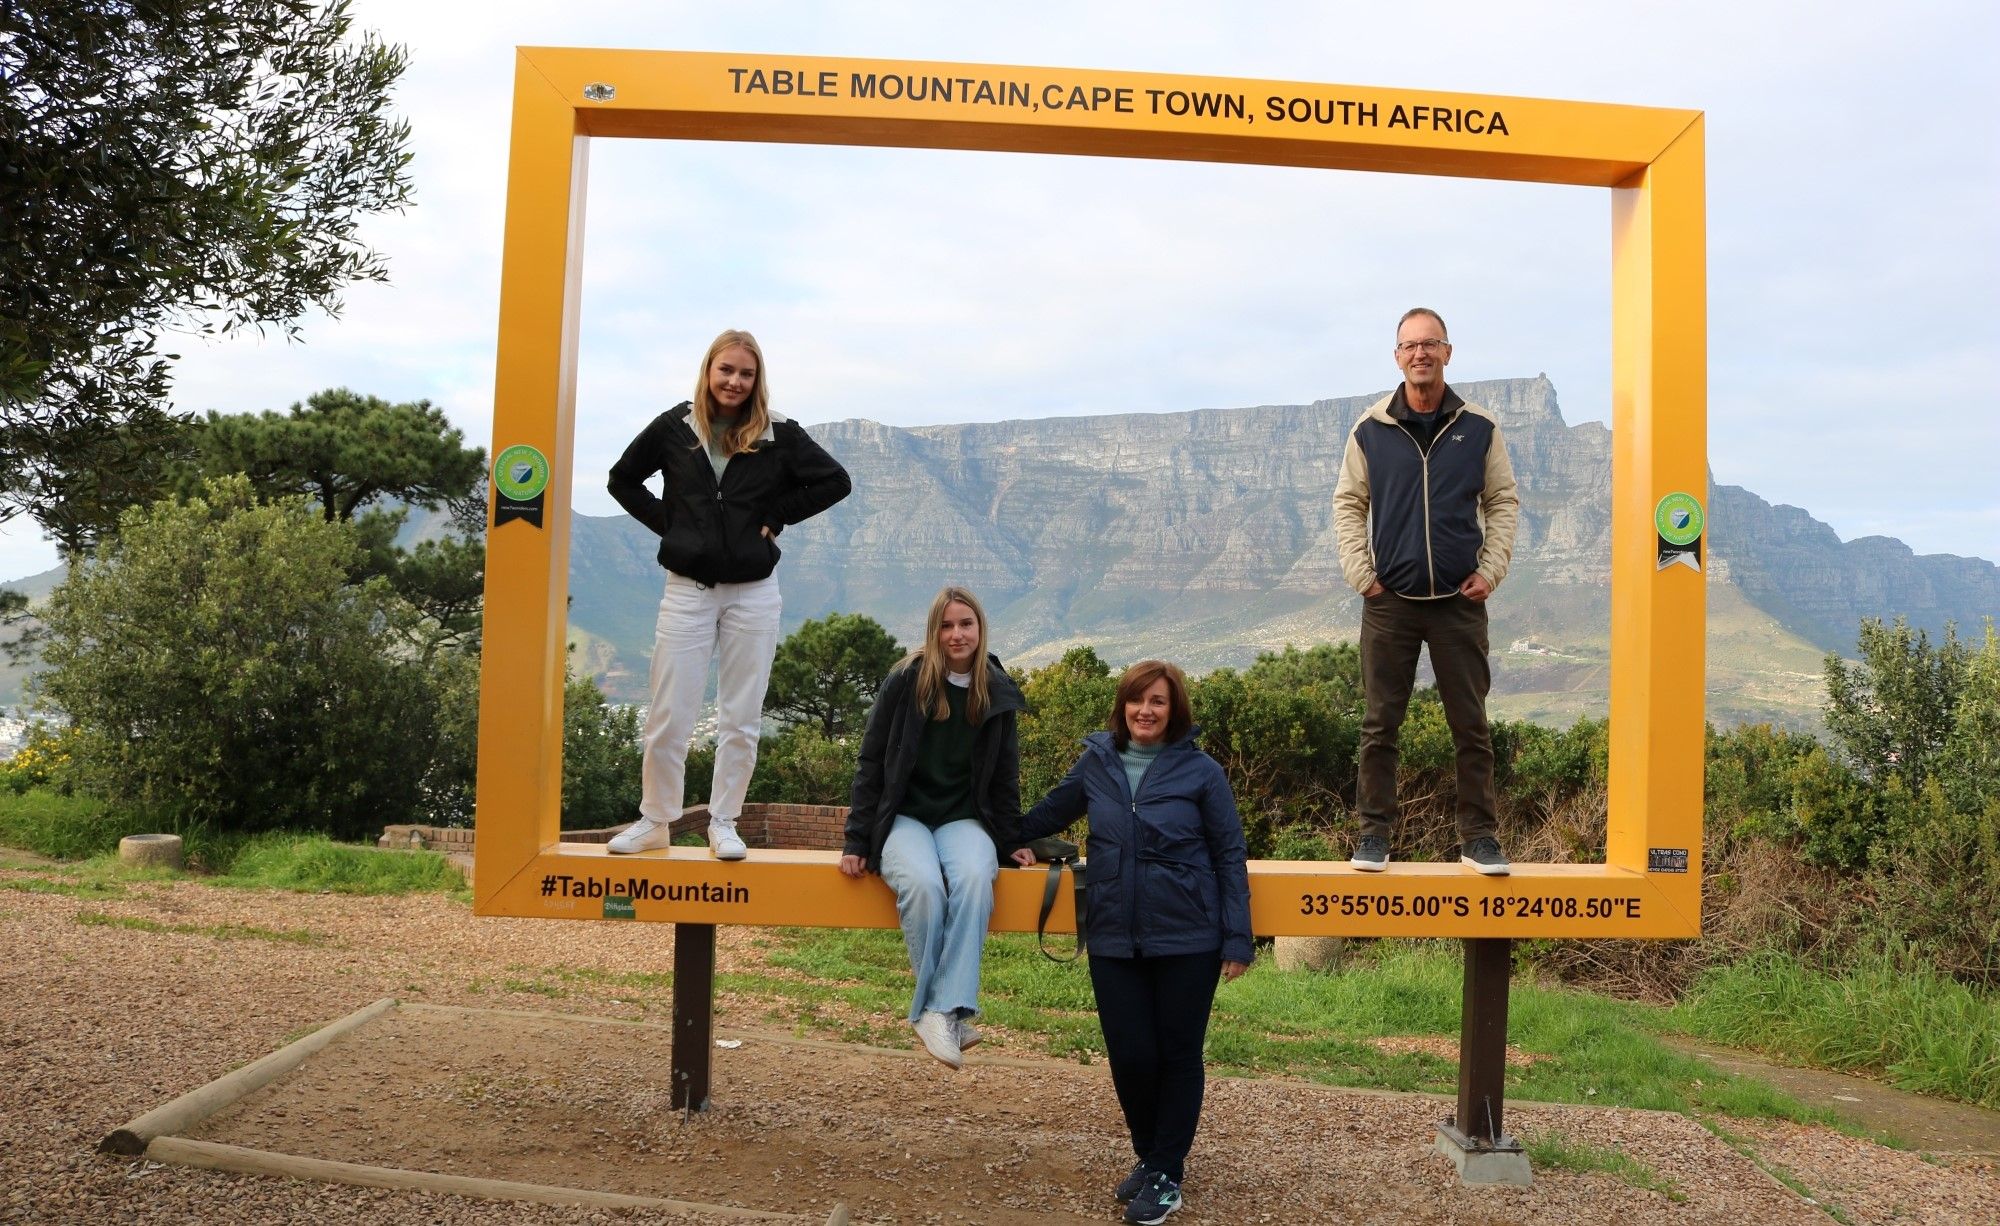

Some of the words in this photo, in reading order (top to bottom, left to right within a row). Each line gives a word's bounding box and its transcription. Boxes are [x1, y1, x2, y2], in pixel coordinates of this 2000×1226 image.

[728, 68, 839, 97] TABLE
[1144, 89, 1255, 126] TOWN,
[1265, 96, 1379, 128] SOUTH
[1387, 104, 1511, 137] AFRICA
[541, 875, 749, 903] #TableMountain
[1300, 894, 1470, 917] 33°55'05.00"S
[1479, 896, 1641, 918] 18°24'08.50"E
